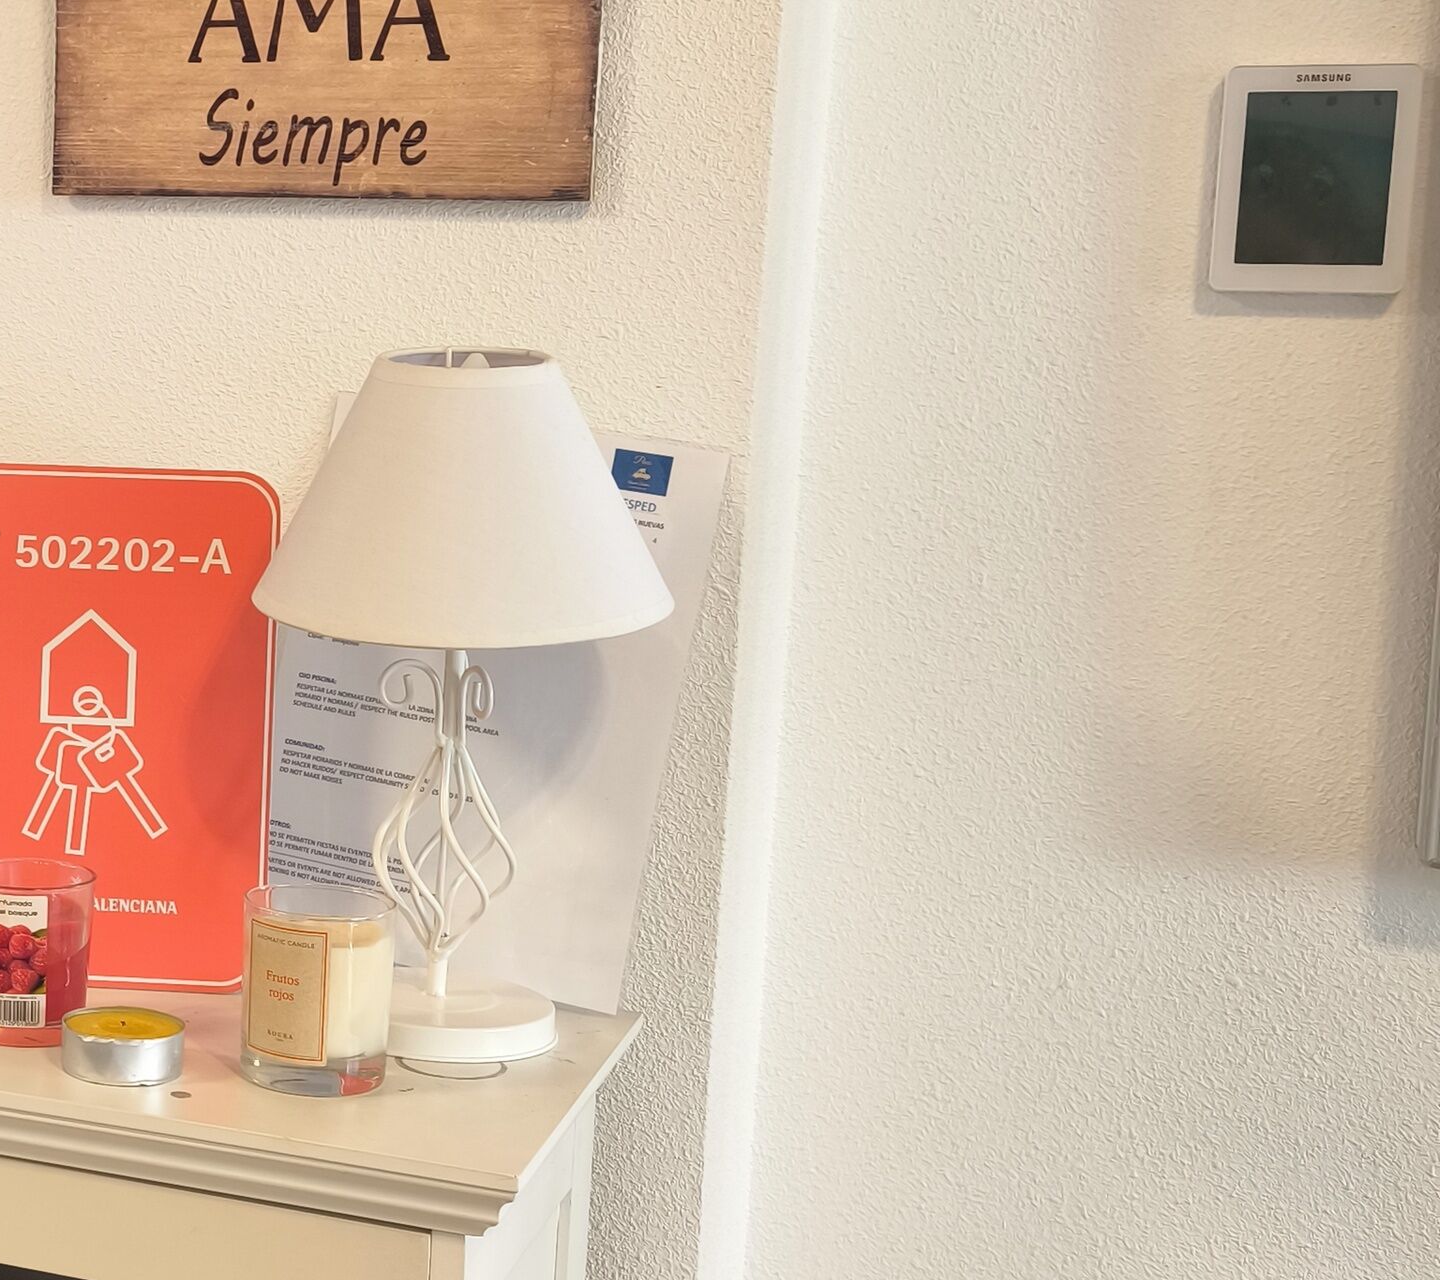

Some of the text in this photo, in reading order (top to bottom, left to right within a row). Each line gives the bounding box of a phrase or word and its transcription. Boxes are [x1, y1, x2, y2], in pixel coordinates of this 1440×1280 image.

[1296, 73, 1352, 83] SAMSUNG
[198, 87, 428, 186] Siempre
[15, 534, 232, 575] 502202-A
[93, 896, 178, 915] ALENCIANA
[266, 970, 300, 986] Frutos
[268, 989, 295, 1001] rojos
